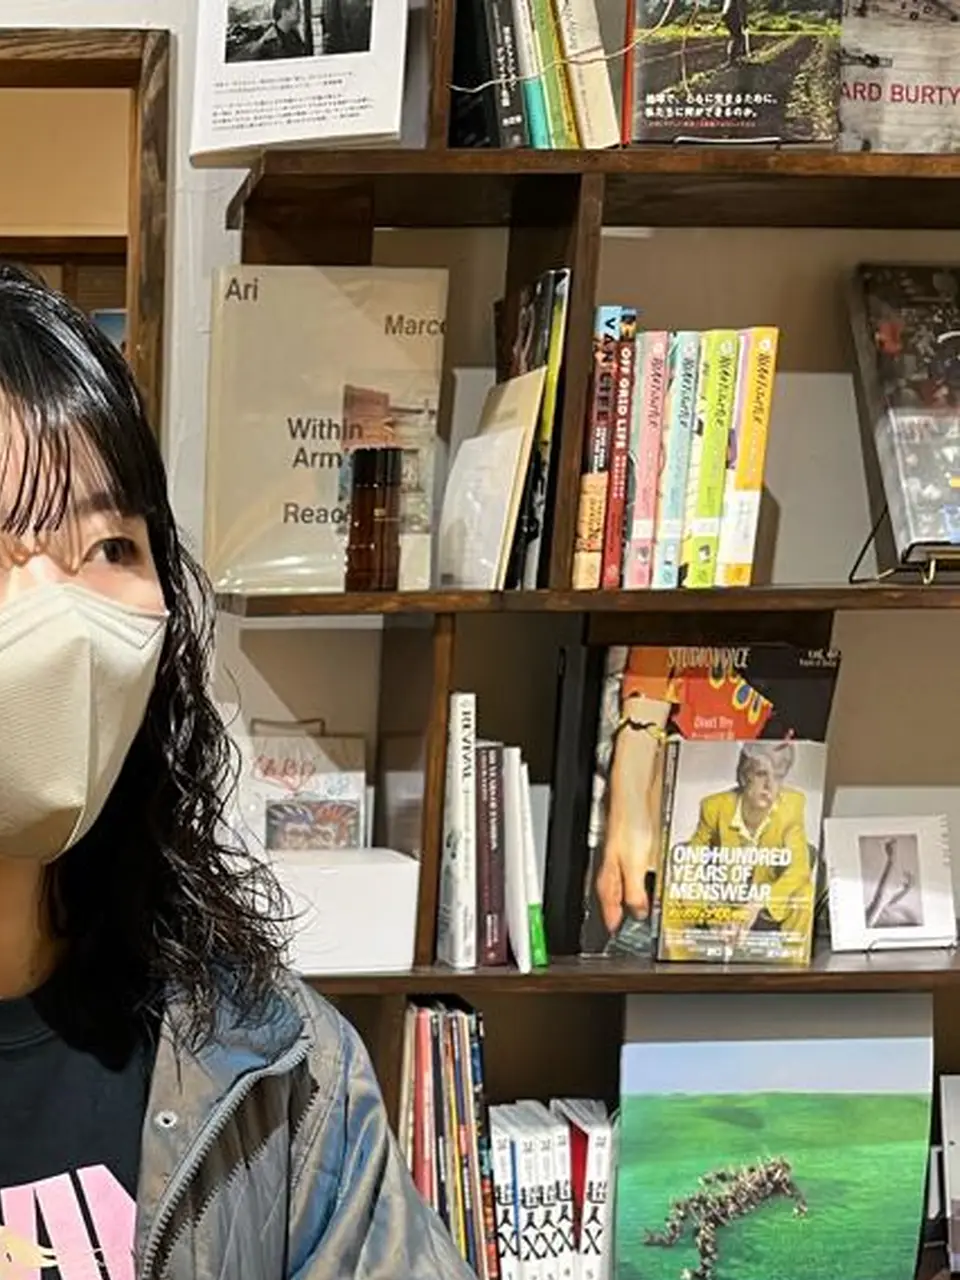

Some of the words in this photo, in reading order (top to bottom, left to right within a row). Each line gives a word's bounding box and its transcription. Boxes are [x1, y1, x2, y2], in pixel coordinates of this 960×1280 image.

[225, 277, 259, 301] Ari
[620, 346, 632, 374] OFF
[286, 417, 364, 441] Within
[673, 846, 713, 865] ONE
[713, 847, 792, 867] HUNDRED
[673, 864, 728, 883] YEARS
[731, 865, 754, 883] OF
[669, 883, 772, 902] MENSWEAR
